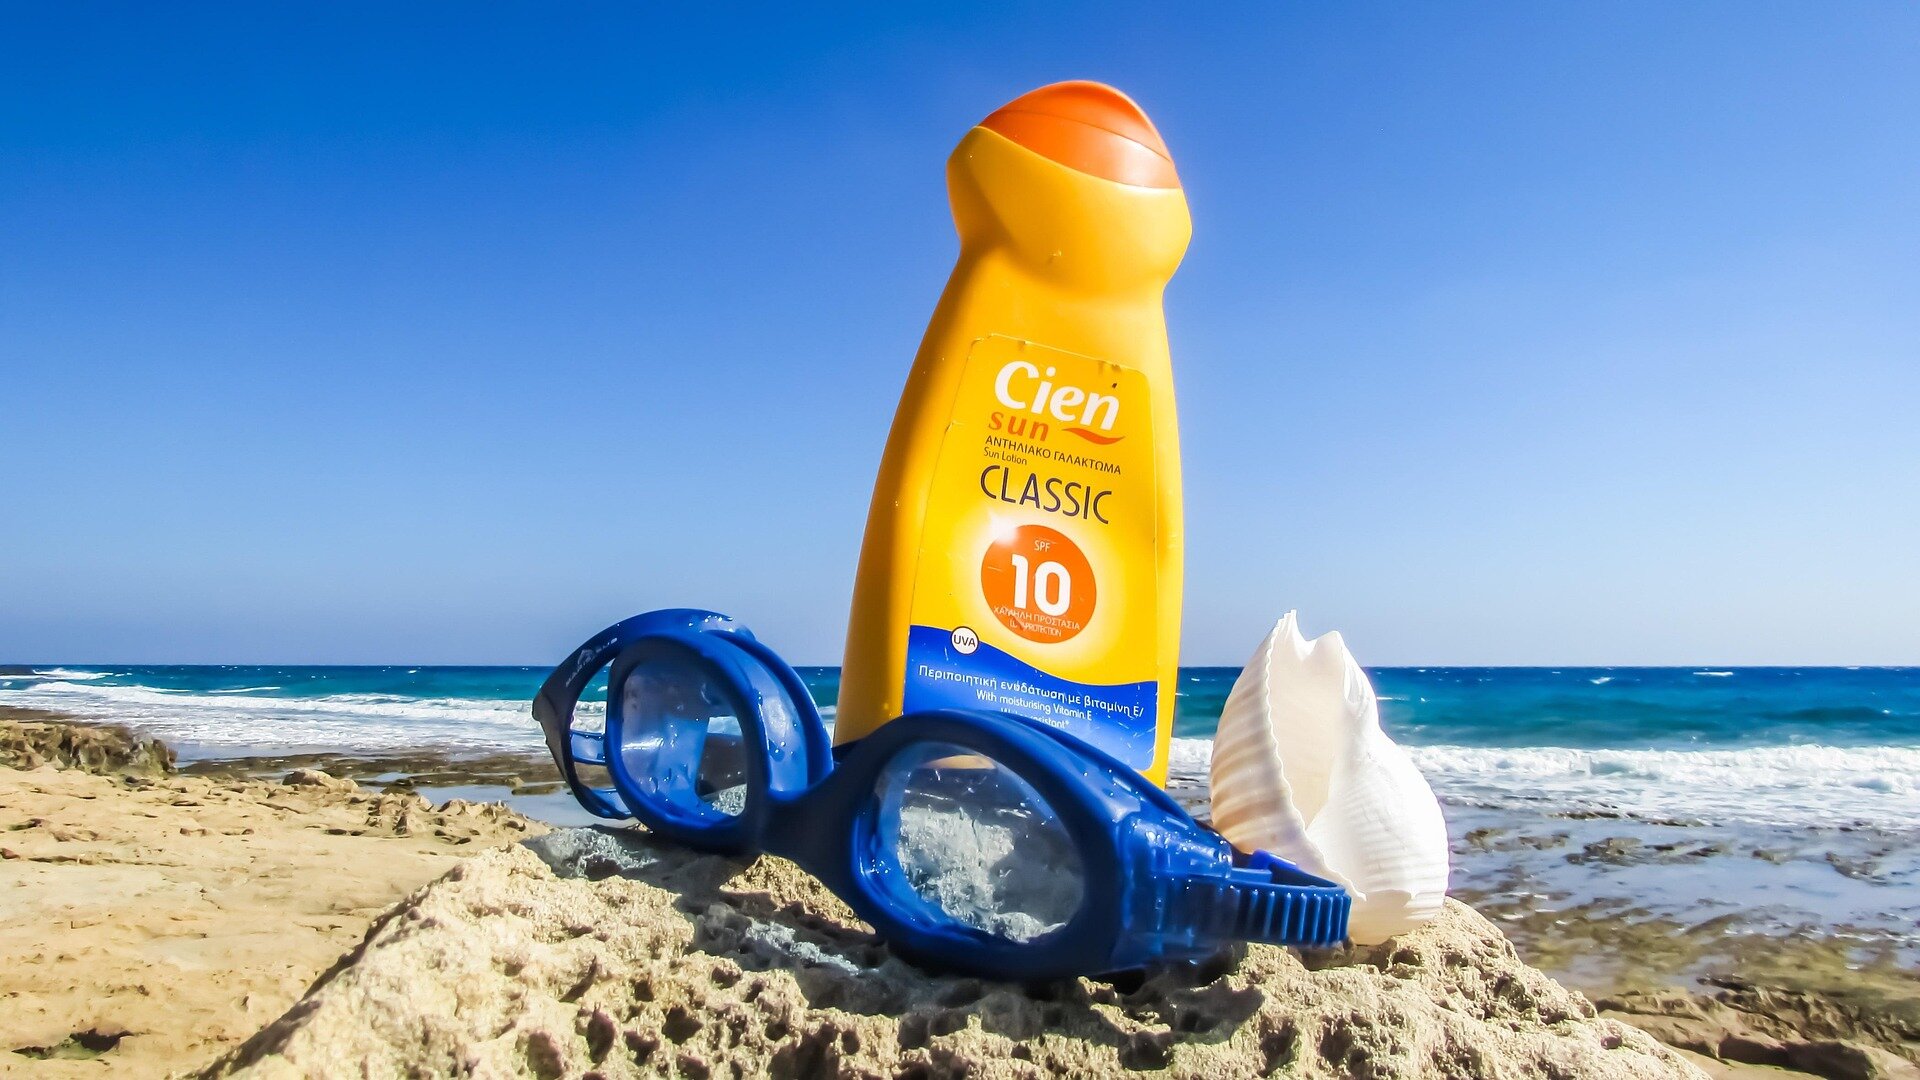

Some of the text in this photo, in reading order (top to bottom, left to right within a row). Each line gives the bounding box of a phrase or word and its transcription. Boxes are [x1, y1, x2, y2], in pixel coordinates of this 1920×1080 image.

[994, 360, 1120, 431] Cien
[988, 411, 1049, 442] sun
[983, 446, 1028, 465] Sun Lotion
[985, 435, 1121, 475] ΑΝΤΗΛΙΑΚΟ ΓΑΛΑΚΤΩΜΑ
[980, 464, 1112, 525] CLASSIC
[1034, 539, 1051, 552] SPF
[1011, 553, 1072, 617] 10
[1033, 613, 1080, 630] ΠΡΟΣΤΑΣΙΑ
[953, 634, 976, 648] UVA
[919, 664, 997, 690] Περιποιητική
[1068, 694, 1082, 705] με
[1084, 695, 1131, 717] βιταμίνη
[976, 689, 997, 702] With
[1000, 696, 1051, 715] moisturising
[1053, 703, 1086, 720] Vitamin
[1087, 710, 1092, 721] E
